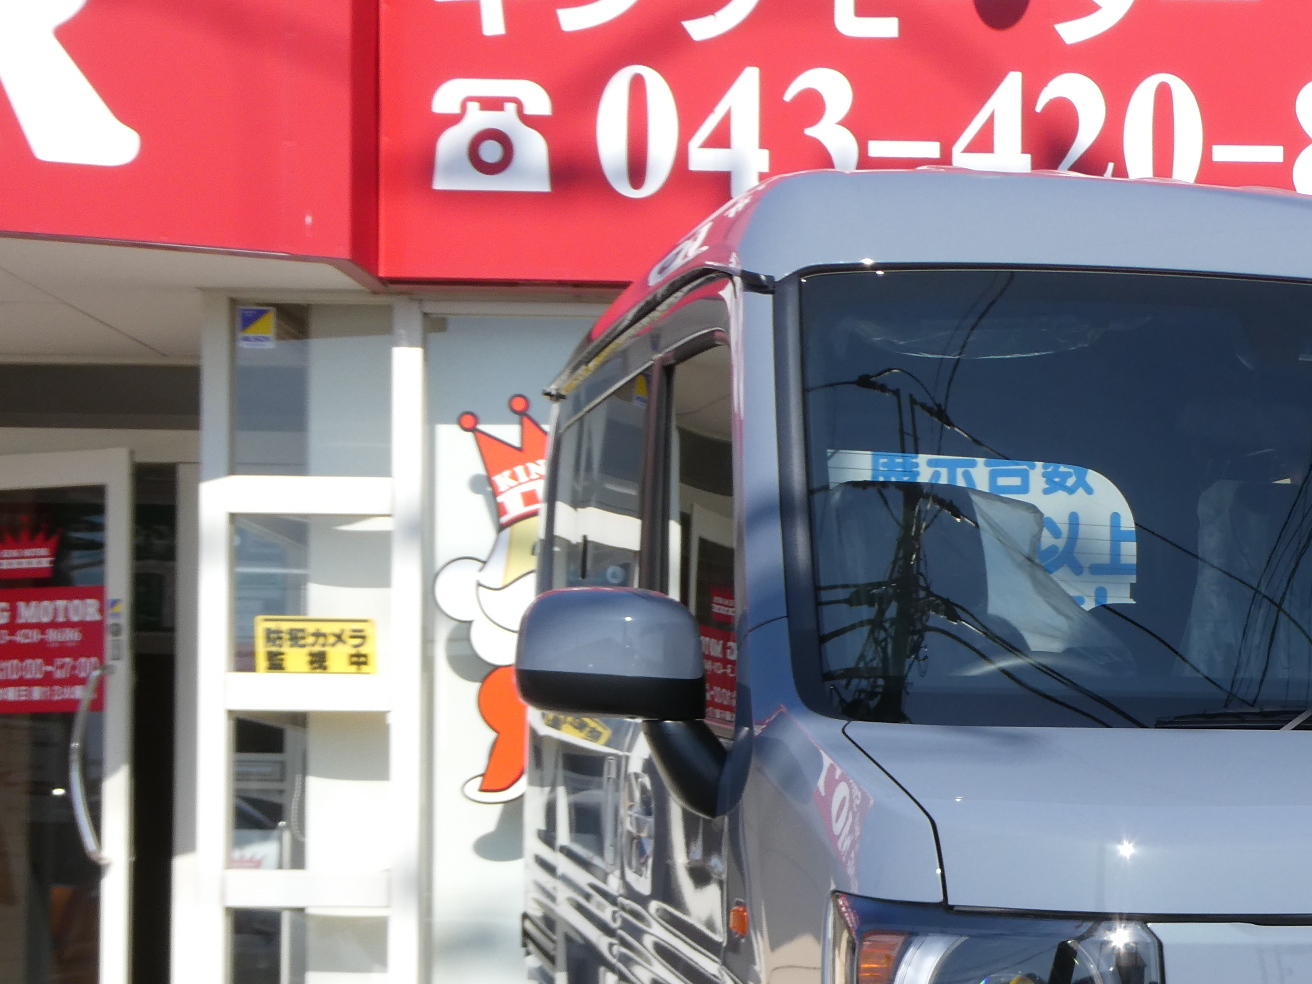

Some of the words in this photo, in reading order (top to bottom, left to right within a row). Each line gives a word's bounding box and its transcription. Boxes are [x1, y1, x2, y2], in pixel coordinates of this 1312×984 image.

[491, 459, 546, 492] KIN
[16, 599, 102, 623] MOTOR
[265, 625, 367, 648] 防犯カメラ
